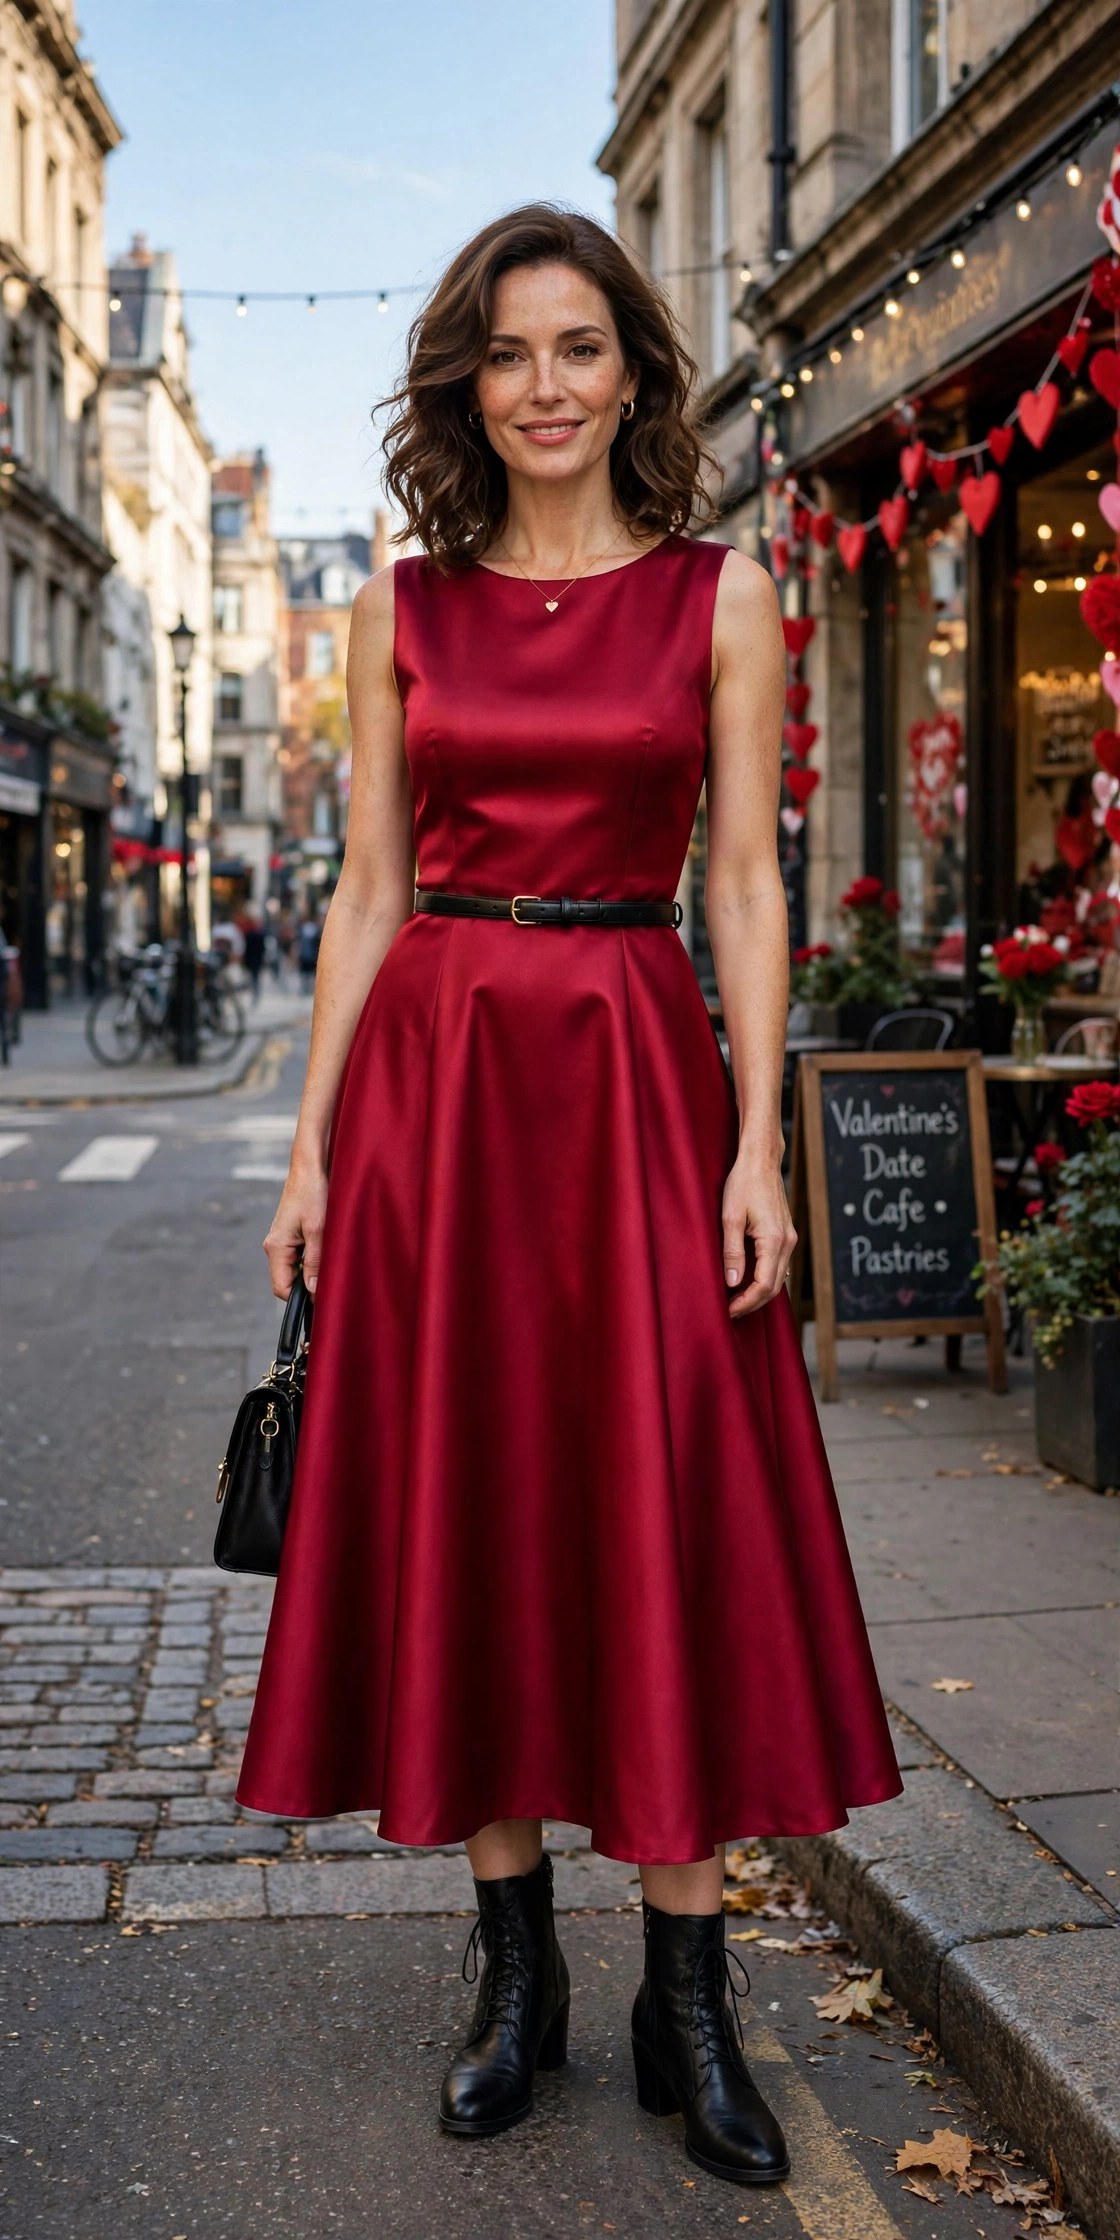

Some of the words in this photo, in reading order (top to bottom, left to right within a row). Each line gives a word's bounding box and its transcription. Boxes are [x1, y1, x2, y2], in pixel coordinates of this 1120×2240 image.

[831, 1098, 958, 1137] Valentine's
[861, 1144, 926, 1181] Date
[863, 1188, 925, 1232] Cafe
[850, 1235, 949, 1277] Pastries
